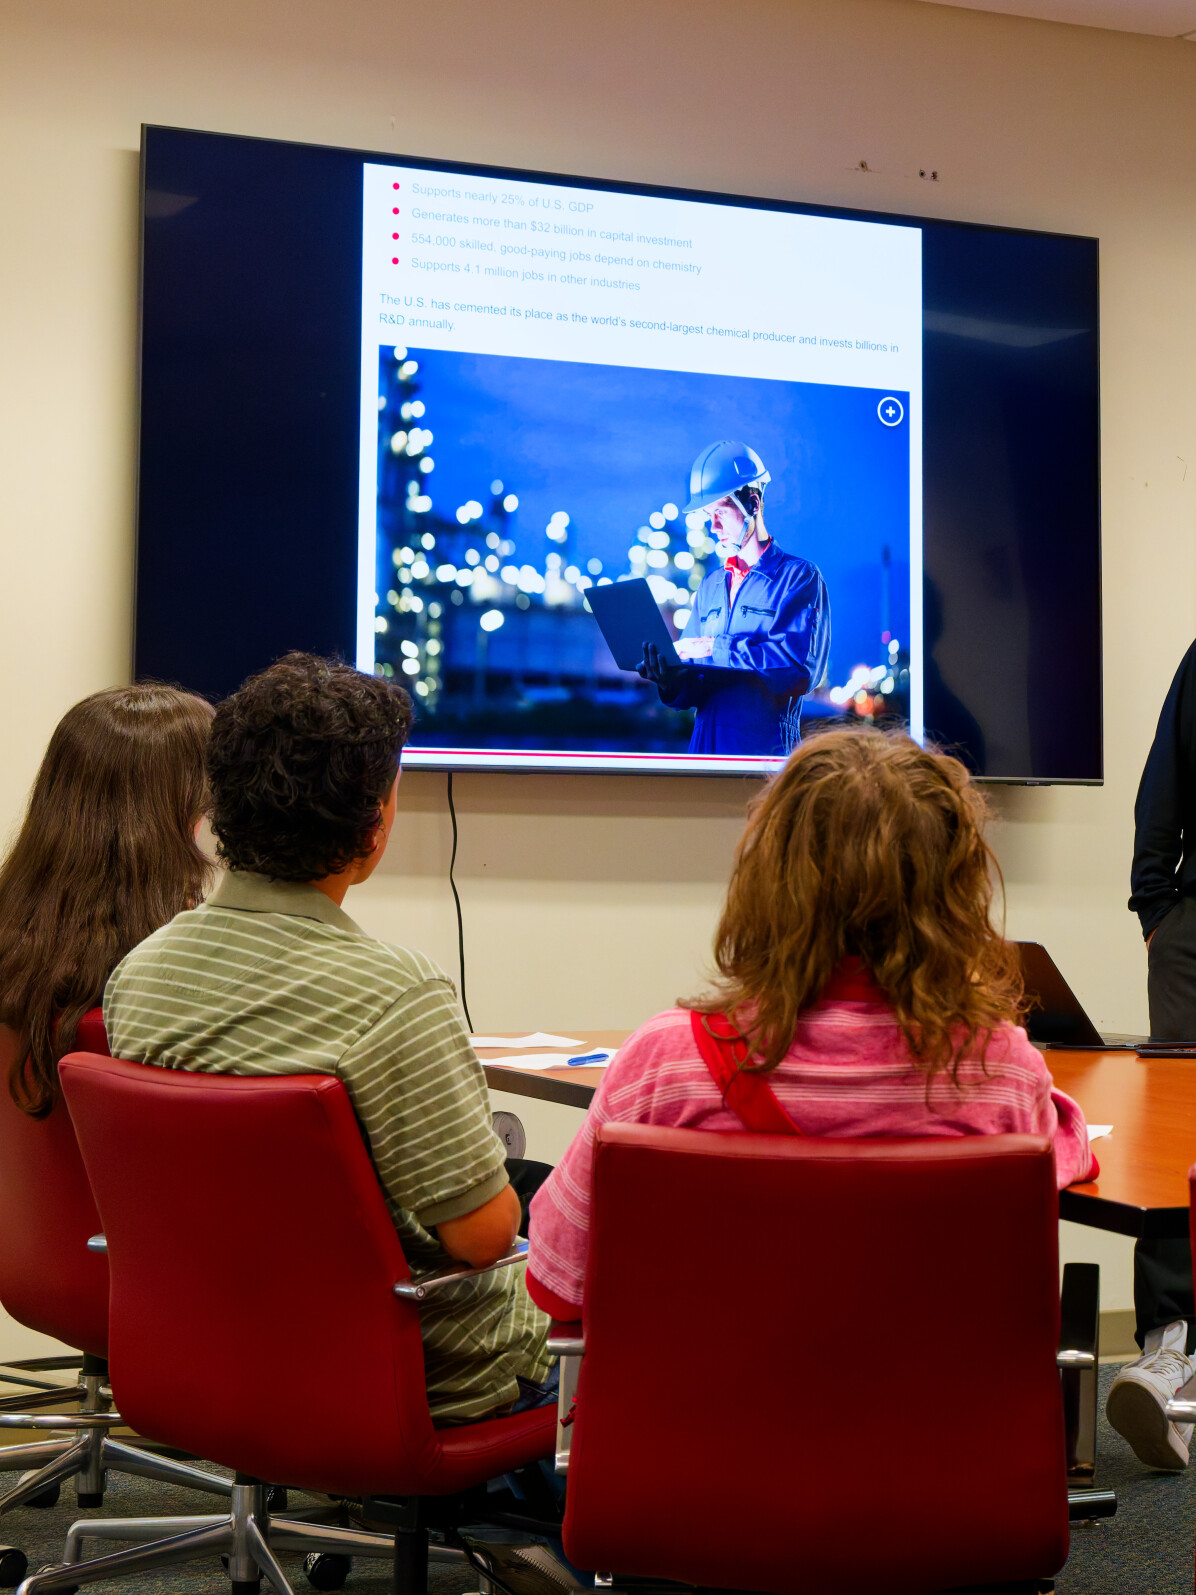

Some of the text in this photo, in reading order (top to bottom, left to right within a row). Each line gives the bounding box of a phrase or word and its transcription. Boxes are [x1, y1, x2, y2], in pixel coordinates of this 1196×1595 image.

[411, 182, 594, 213] Supports nearly 25% of U.S. GDP
[411, 208, 693, 249] Generates more than $32 billion in capital investment
[411, 233, 702, 276] 554,000 skilled, good-paying jobs depend on chemistry
[411, 257, 641, 291] Supports 4.1 million jobs in other industries
[379, 312, 456, 333] R&D annually.
[379, 293, 899, 353] The U.S. has cemented its place as the world's second-largest chemical producer and invests billions in
